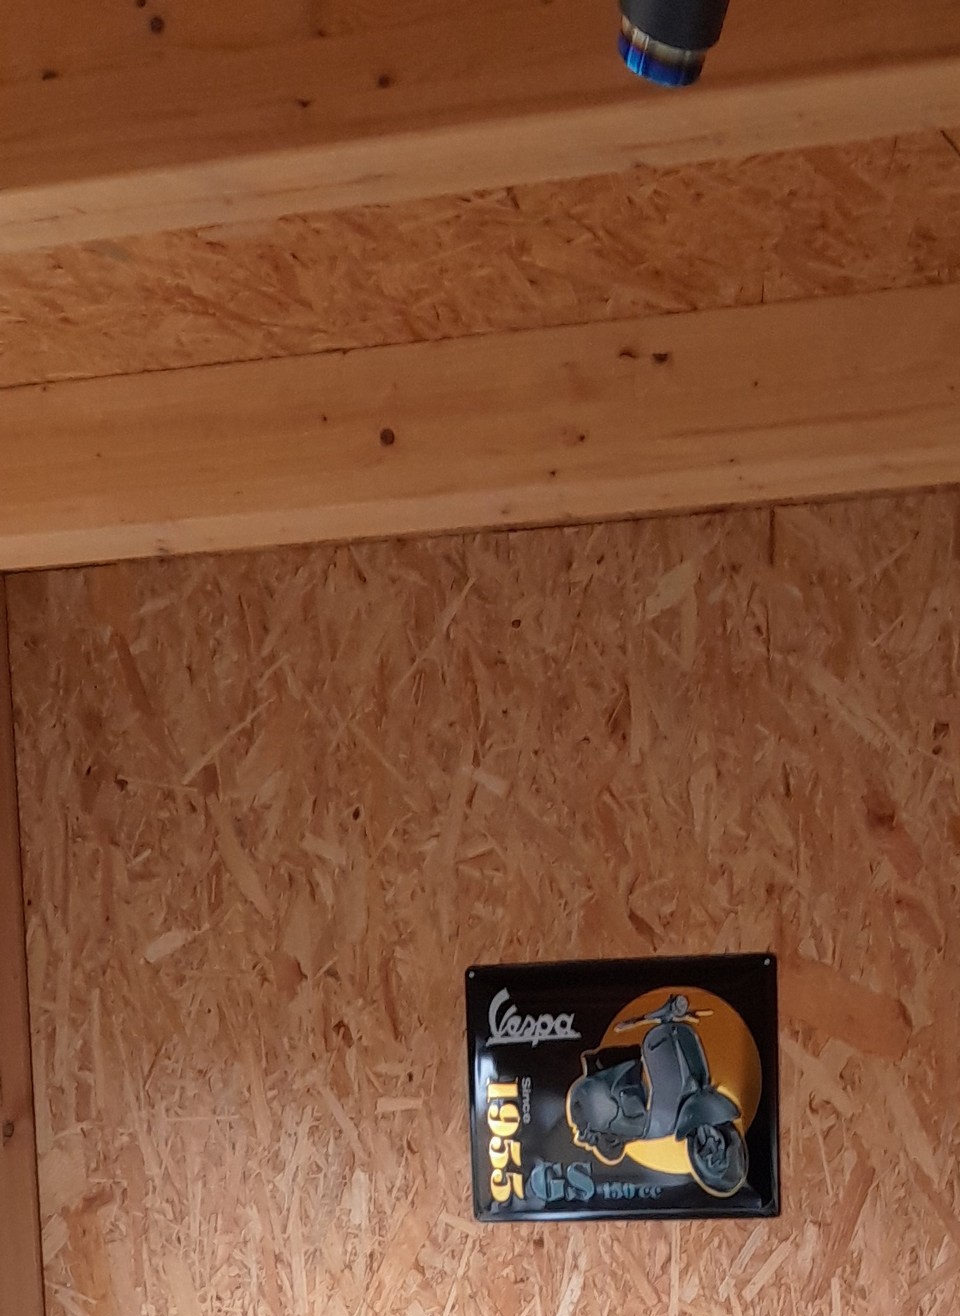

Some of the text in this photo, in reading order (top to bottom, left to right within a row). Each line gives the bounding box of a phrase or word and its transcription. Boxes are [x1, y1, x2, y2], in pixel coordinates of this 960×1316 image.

[485, 987, 582, 1047] Vespa
[521, 1077, 532, 1124] Since
[487, 1077, 524, 1203] 1955
[529, 1160, 595, 1202] GS
